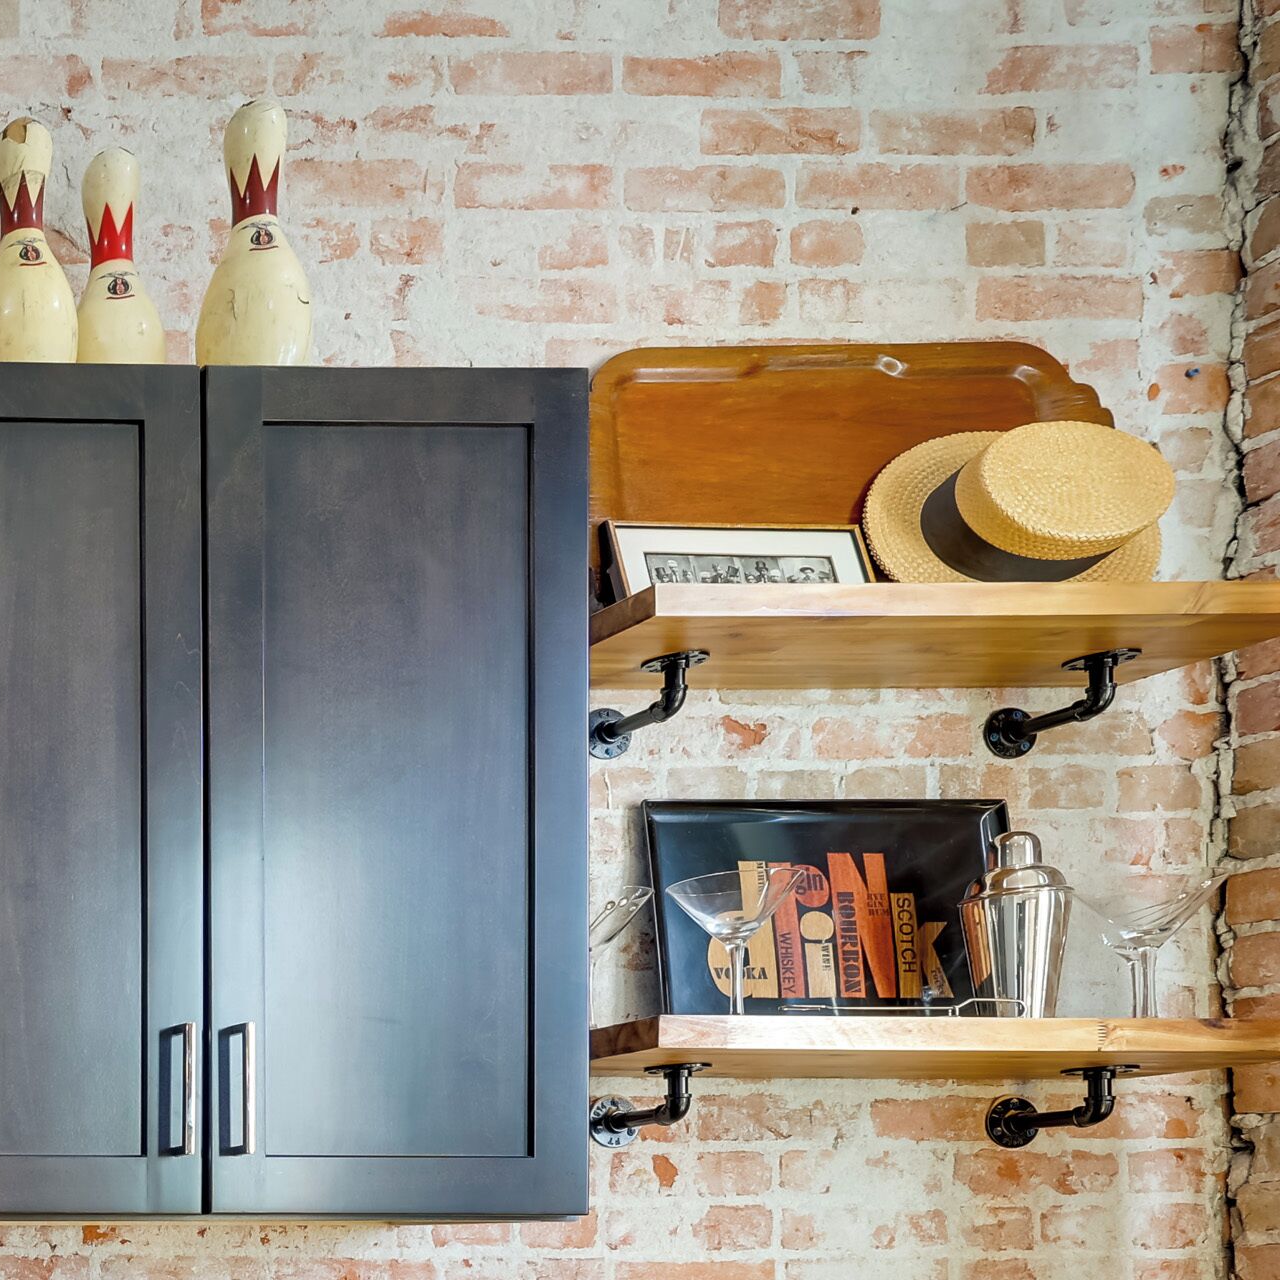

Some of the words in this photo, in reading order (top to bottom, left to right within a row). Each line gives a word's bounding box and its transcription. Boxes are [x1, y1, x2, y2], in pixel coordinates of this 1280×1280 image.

[778, 931, 796, 994] WHISKEY
[837, 892, 862, 993] BOURBON
[896, 897, 917, 974] SCOTCH
[713, 967, 768, 980] VKA
